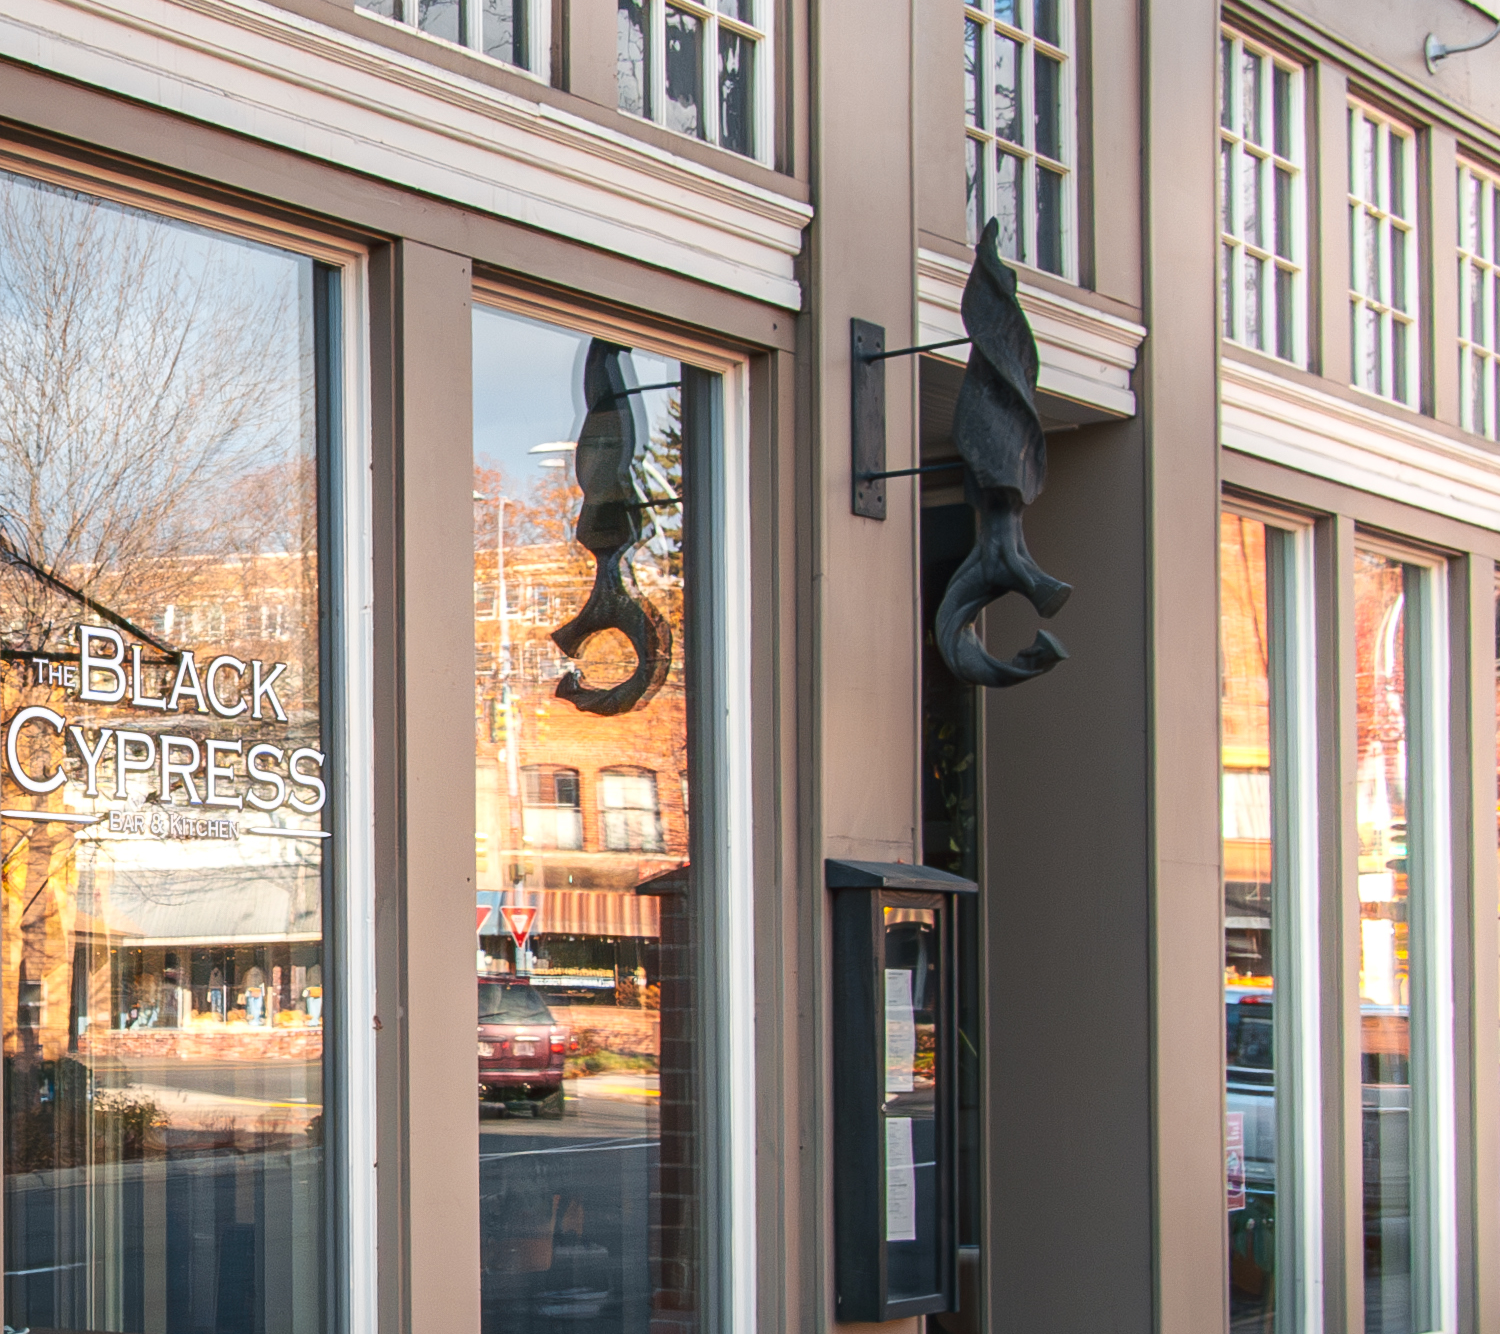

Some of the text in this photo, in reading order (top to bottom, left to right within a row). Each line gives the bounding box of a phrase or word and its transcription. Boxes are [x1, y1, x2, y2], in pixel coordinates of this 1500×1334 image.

[32, 622, 288, 723] THE BLACK
[6, 705, 328, 814] CYPRESS
[109, 810, 240, 840] BAR & KITCHEN
